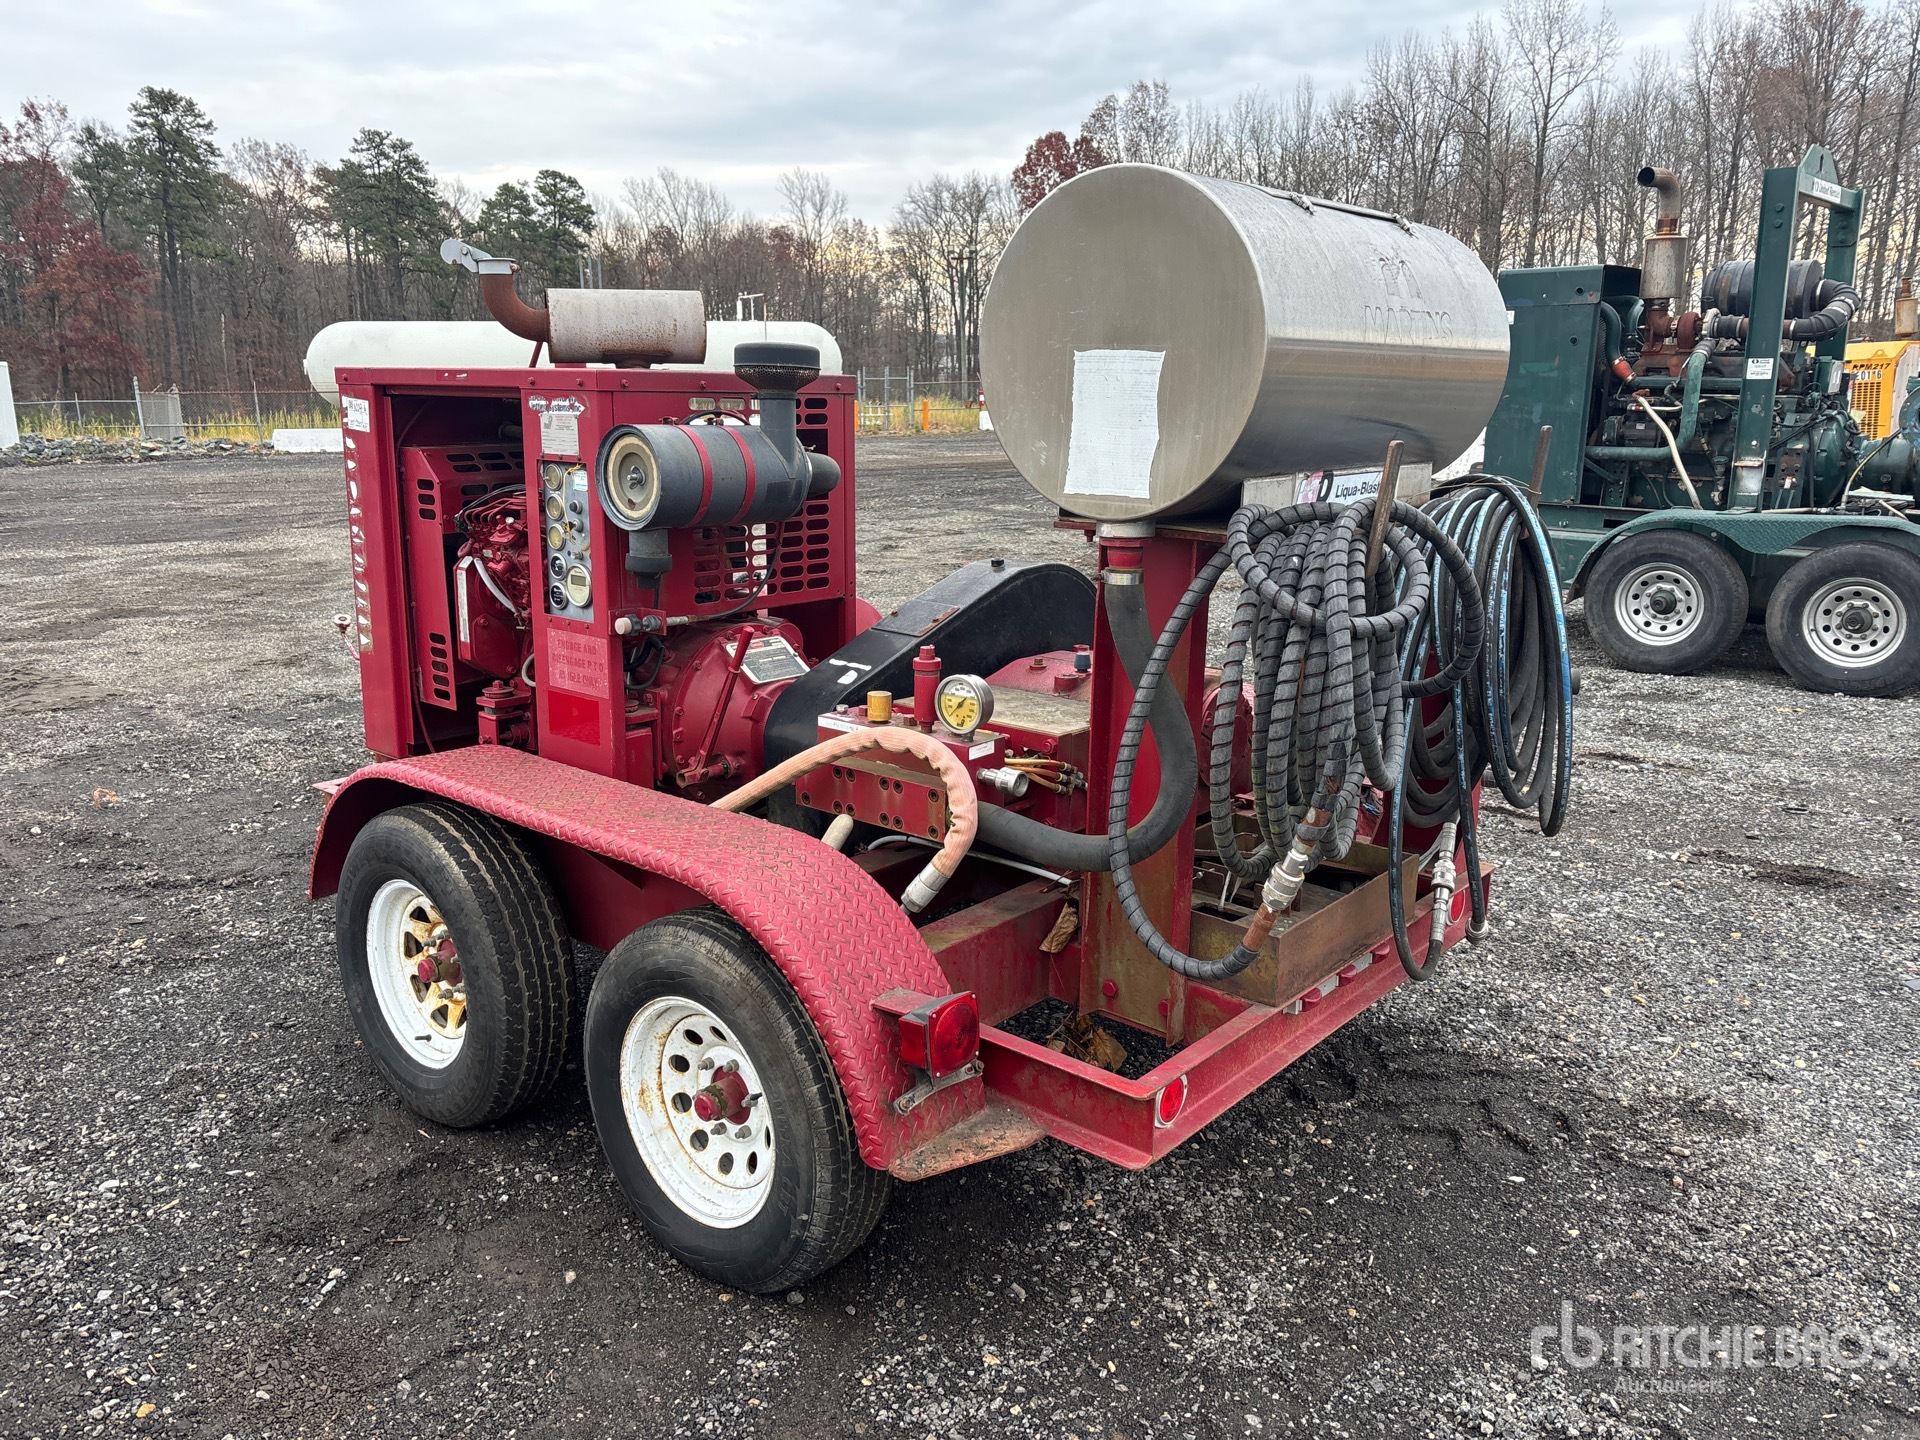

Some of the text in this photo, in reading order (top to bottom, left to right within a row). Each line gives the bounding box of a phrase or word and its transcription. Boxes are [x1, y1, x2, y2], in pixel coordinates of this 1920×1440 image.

[1852, 362, 1891, 371] RPM217
[557, 639, 597, 656] ENGAGE AND
